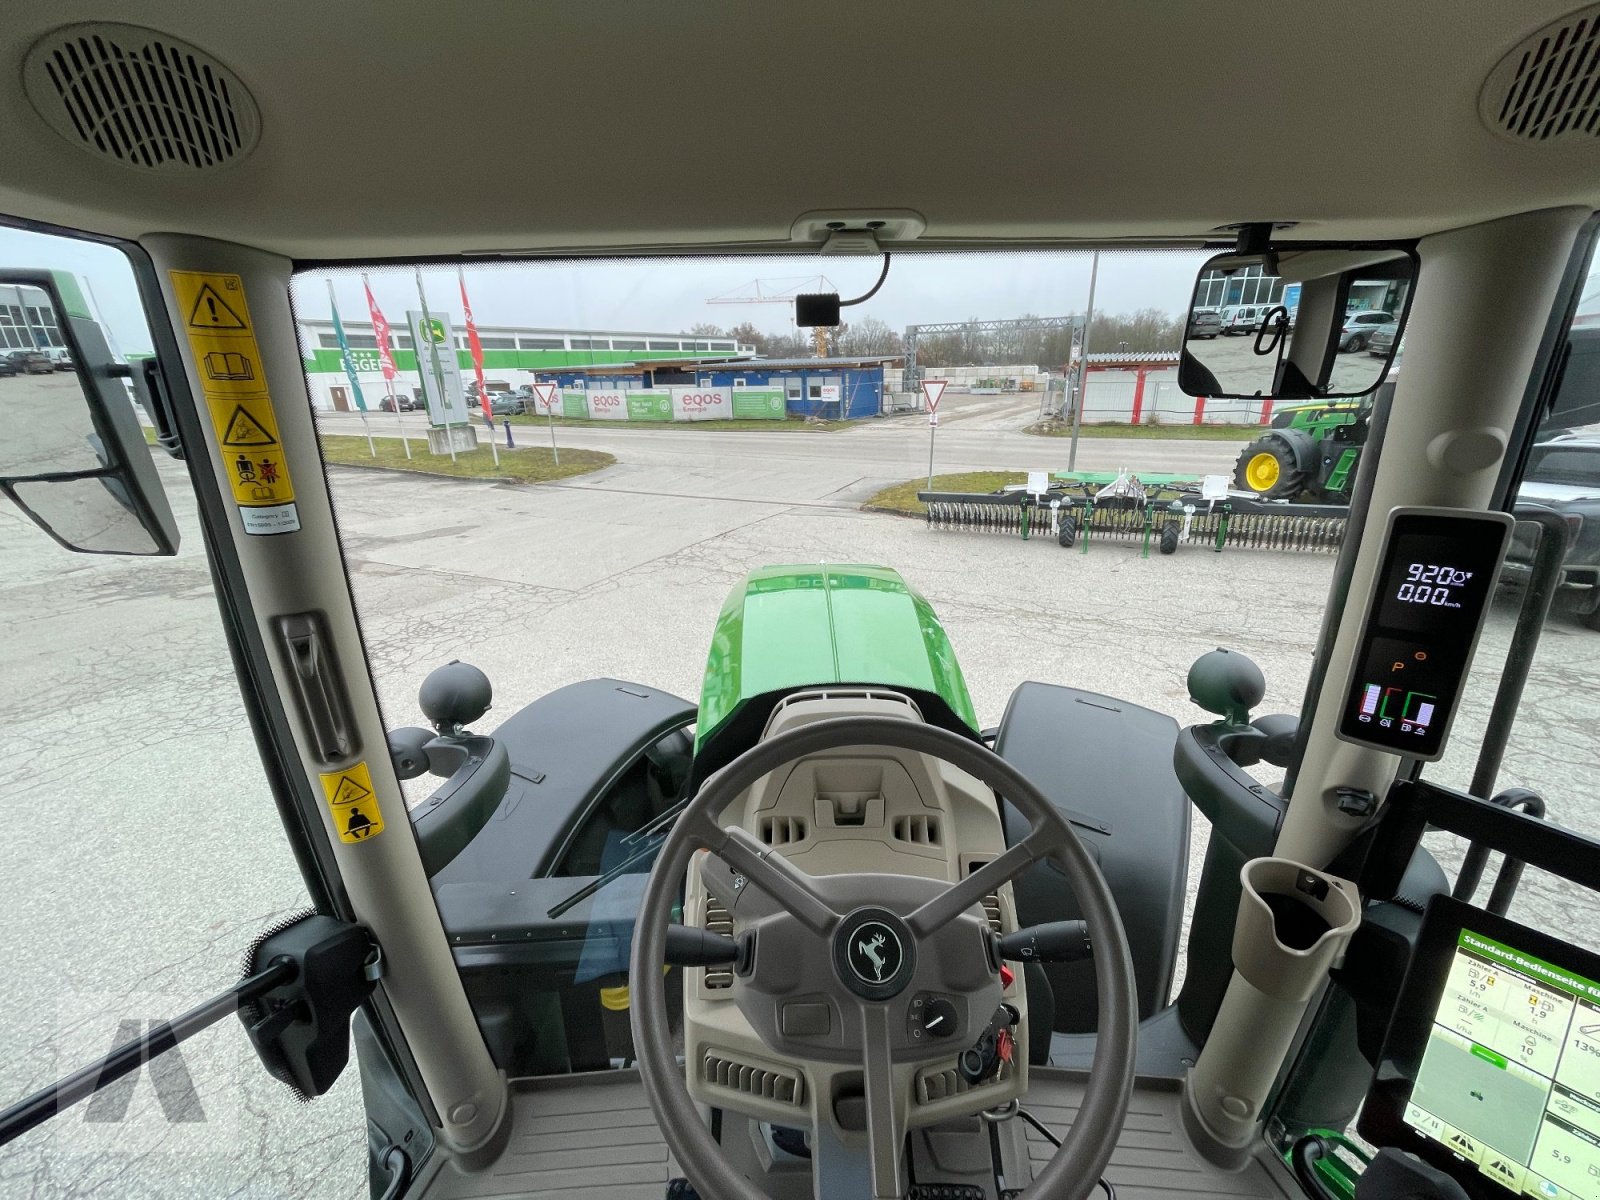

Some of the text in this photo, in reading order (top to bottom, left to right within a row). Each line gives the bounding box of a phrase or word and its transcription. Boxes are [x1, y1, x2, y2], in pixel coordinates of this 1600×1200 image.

[682, 393, 722, 406] eqos
[1406, 563, 1455, 585] 920
[1444, 601, 1461, 609] km/h
[1463, 934, 1586, 992] Standard-Bedienseite
[1523, 983, 1563, 1005] Maschine
[1513, 1020, 1553, 1043] Maschine
[1521, 1045, 1535, 1056] 10
